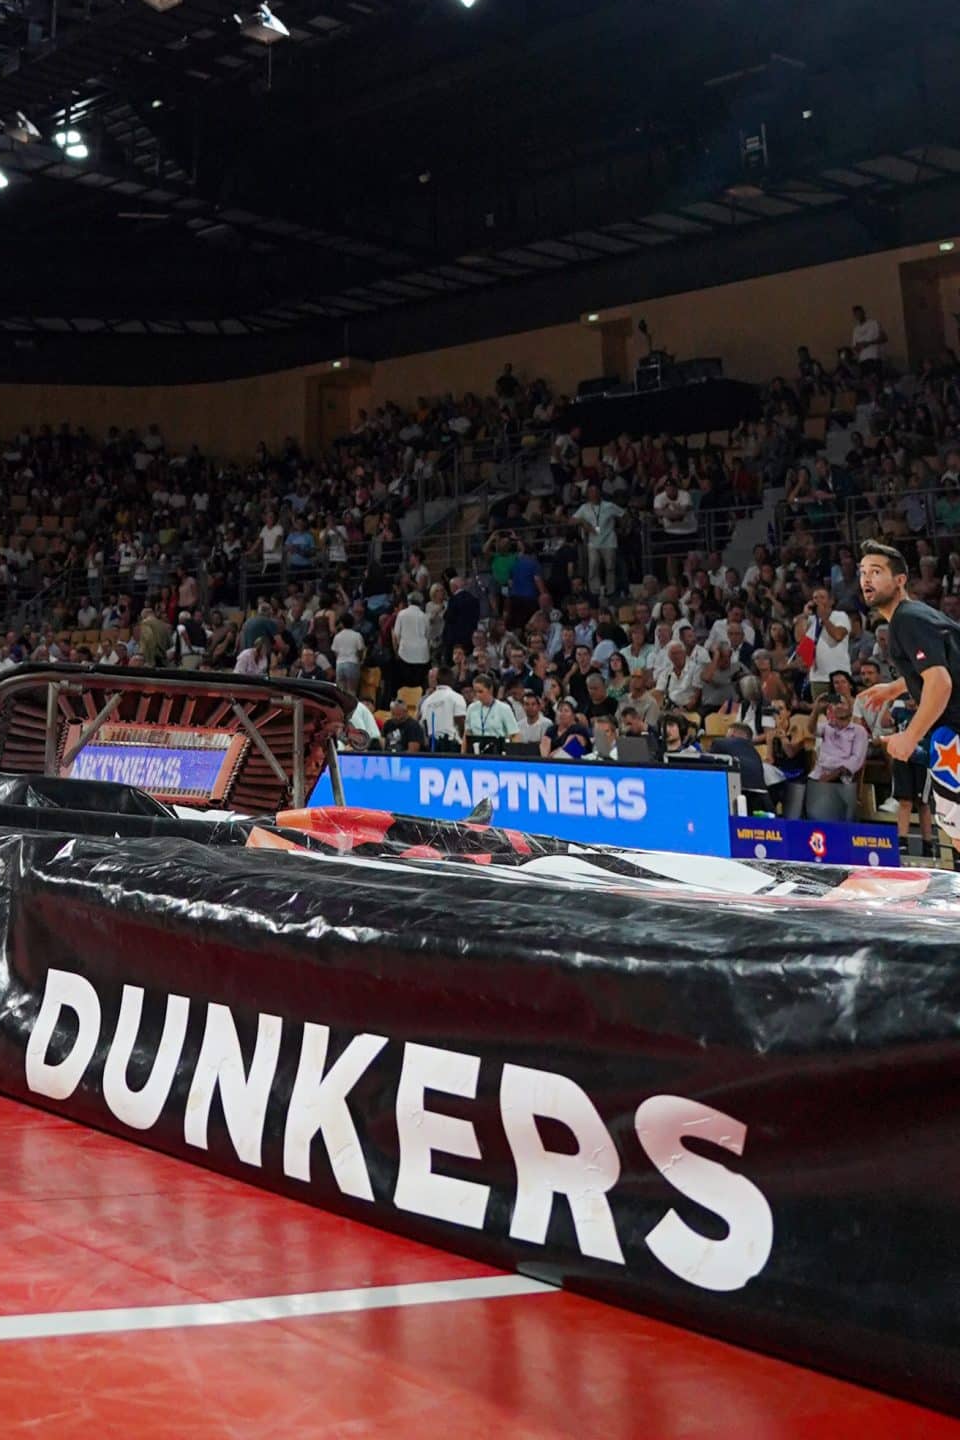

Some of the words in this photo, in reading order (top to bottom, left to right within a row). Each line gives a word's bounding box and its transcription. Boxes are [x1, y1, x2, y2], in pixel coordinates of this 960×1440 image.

[419, 767, 647, 821] PARTNERS
[766, 830, 783, 841] ALL
[878, 838, 892, 849] ALL
[24, 968, 774, 1292] DUNKERS
